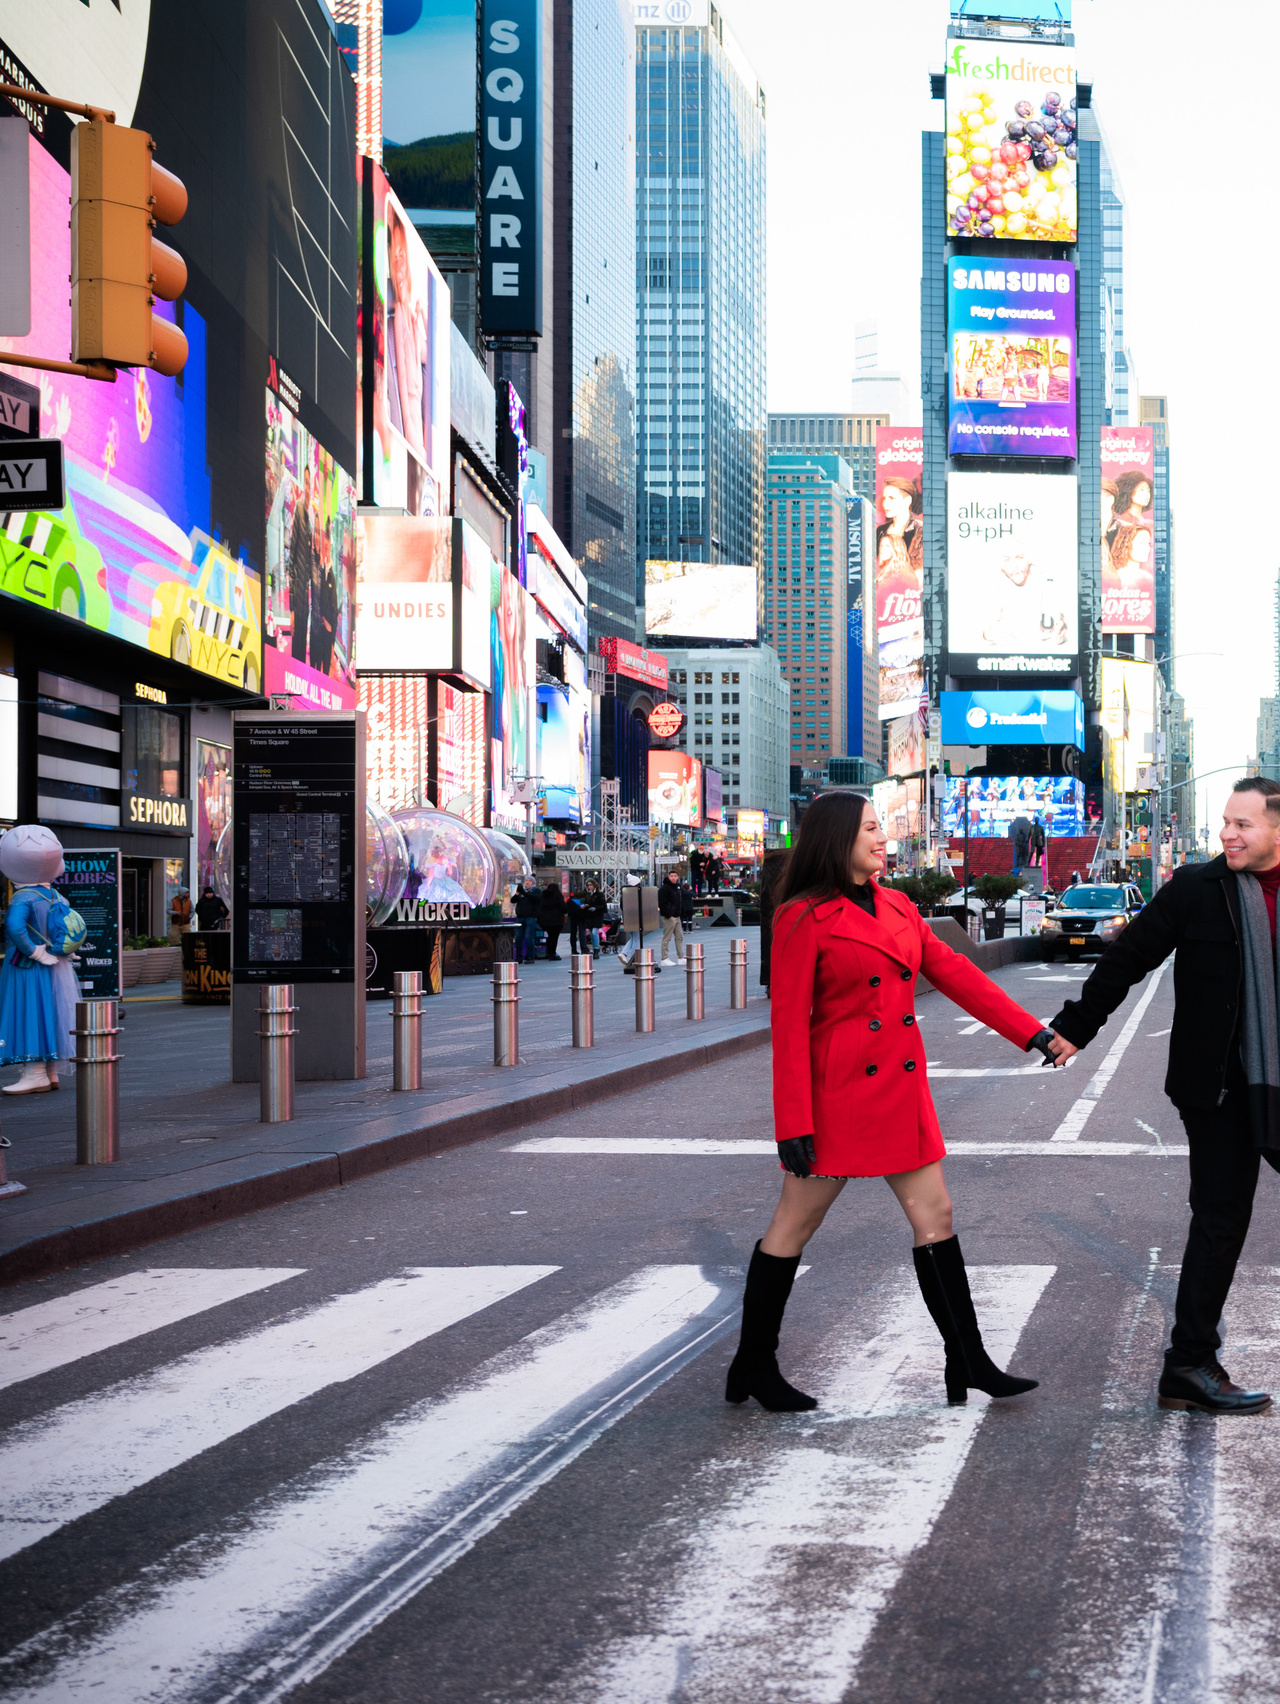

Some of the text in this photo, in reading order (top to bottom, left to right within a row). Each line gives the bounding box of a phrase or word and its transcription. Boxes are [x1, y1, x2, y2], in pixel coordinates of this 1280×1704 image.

[947, 46, 1074, 85] freshdirect
[486, 20, 524, 296] SQUARE
[953, 269, 1070, 293] SAMSUNG
[970, 306, 1056, 320] Play Grounded.
[957, 424, 1070, 438] No console required.
[958, 502, 1033, 520] alkaline
[958, 522, 1013, 542] 9+pH
[374, 603, 446, 618] UNDIES
[197, 639, 240, 680] NYC
[136, 683, 167, 704] SEPHORA
[990, 711, 1047, 724] Prudential
[130, 797, 187, 827] SEPHORA
[63, 860, 109, 872] SHOW
[557, 855, 629, 865] SWAROVSKI
[53, 872, 116, 885] GLOBES
[194, 949, 207, 958] THE
